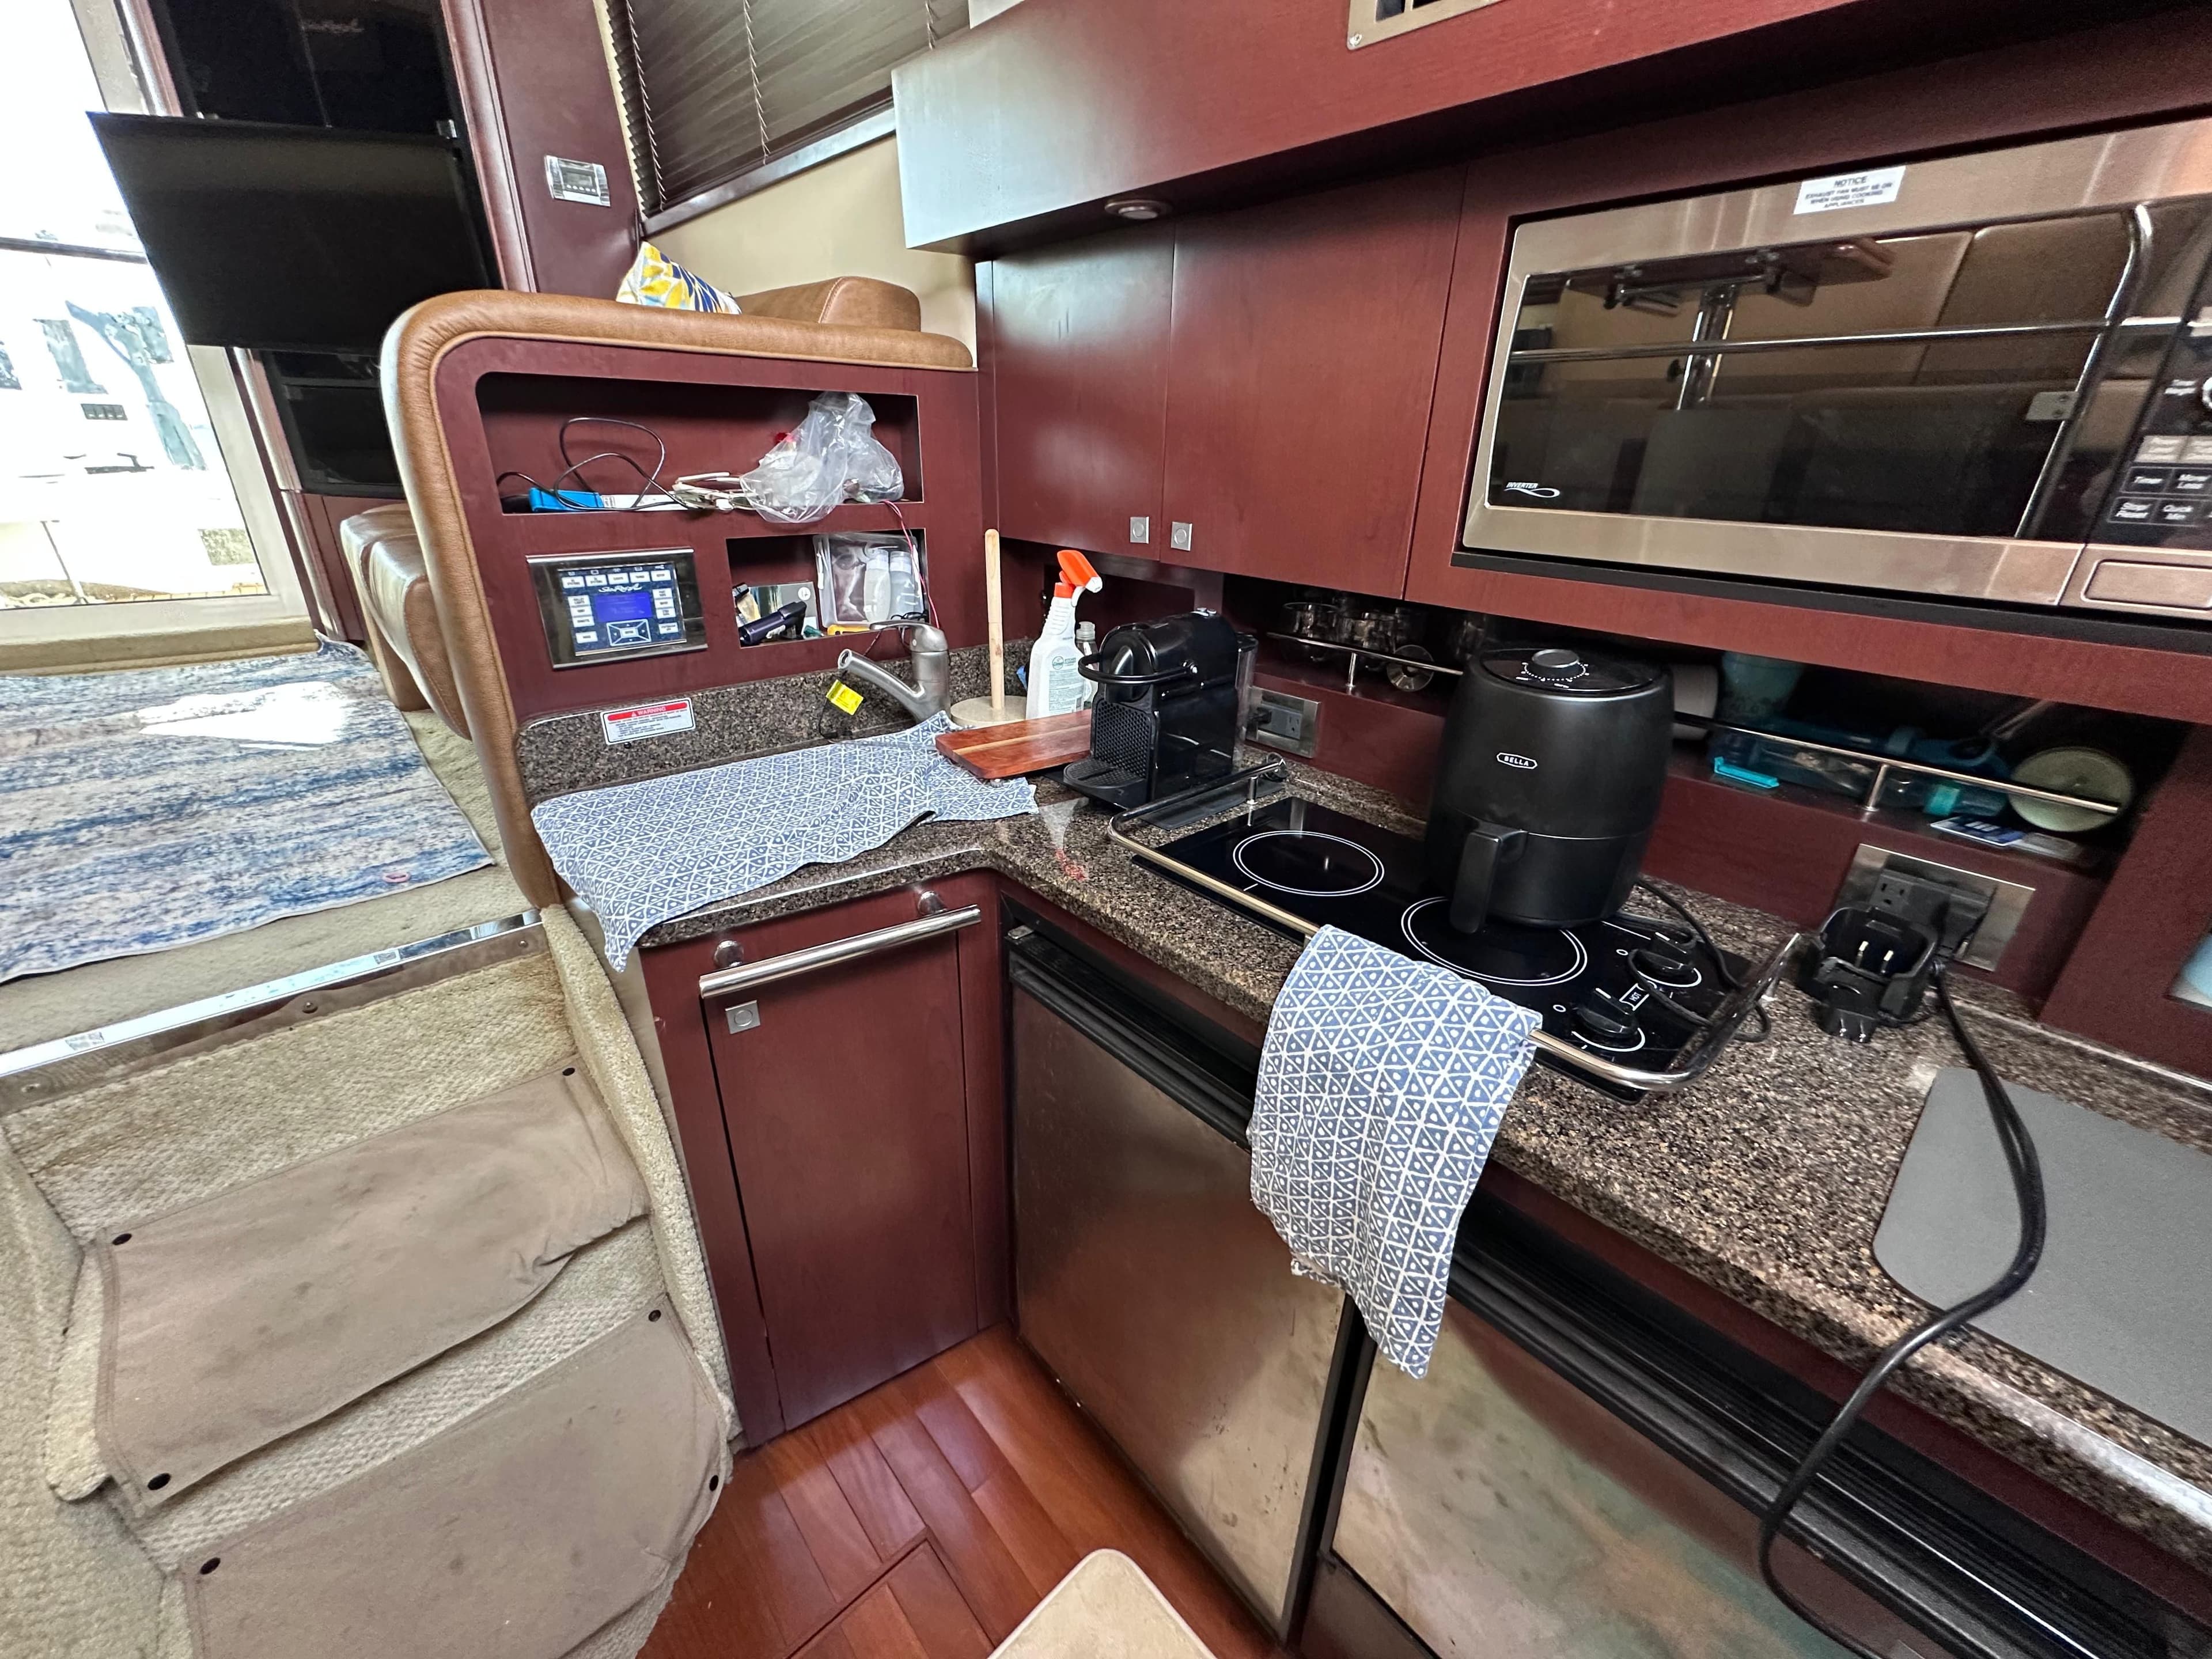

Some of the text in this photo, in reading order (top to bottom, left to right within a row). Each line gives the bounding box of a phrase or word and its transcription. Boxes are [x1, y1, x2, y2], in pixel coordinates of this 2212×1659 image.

[1834, 176, 1868, 186] NOTICE
[1805, 190, 1835, 199] EXHAUST
[1851, 190, 1883, 199] COOKING
[1823, 199, 1865, 208] APPLIANCES
[637, 706, 666, 716] WARNING
[1504, 756, 1529, 766] BELLA
[1628, 992, 1641, 1002] HOT
